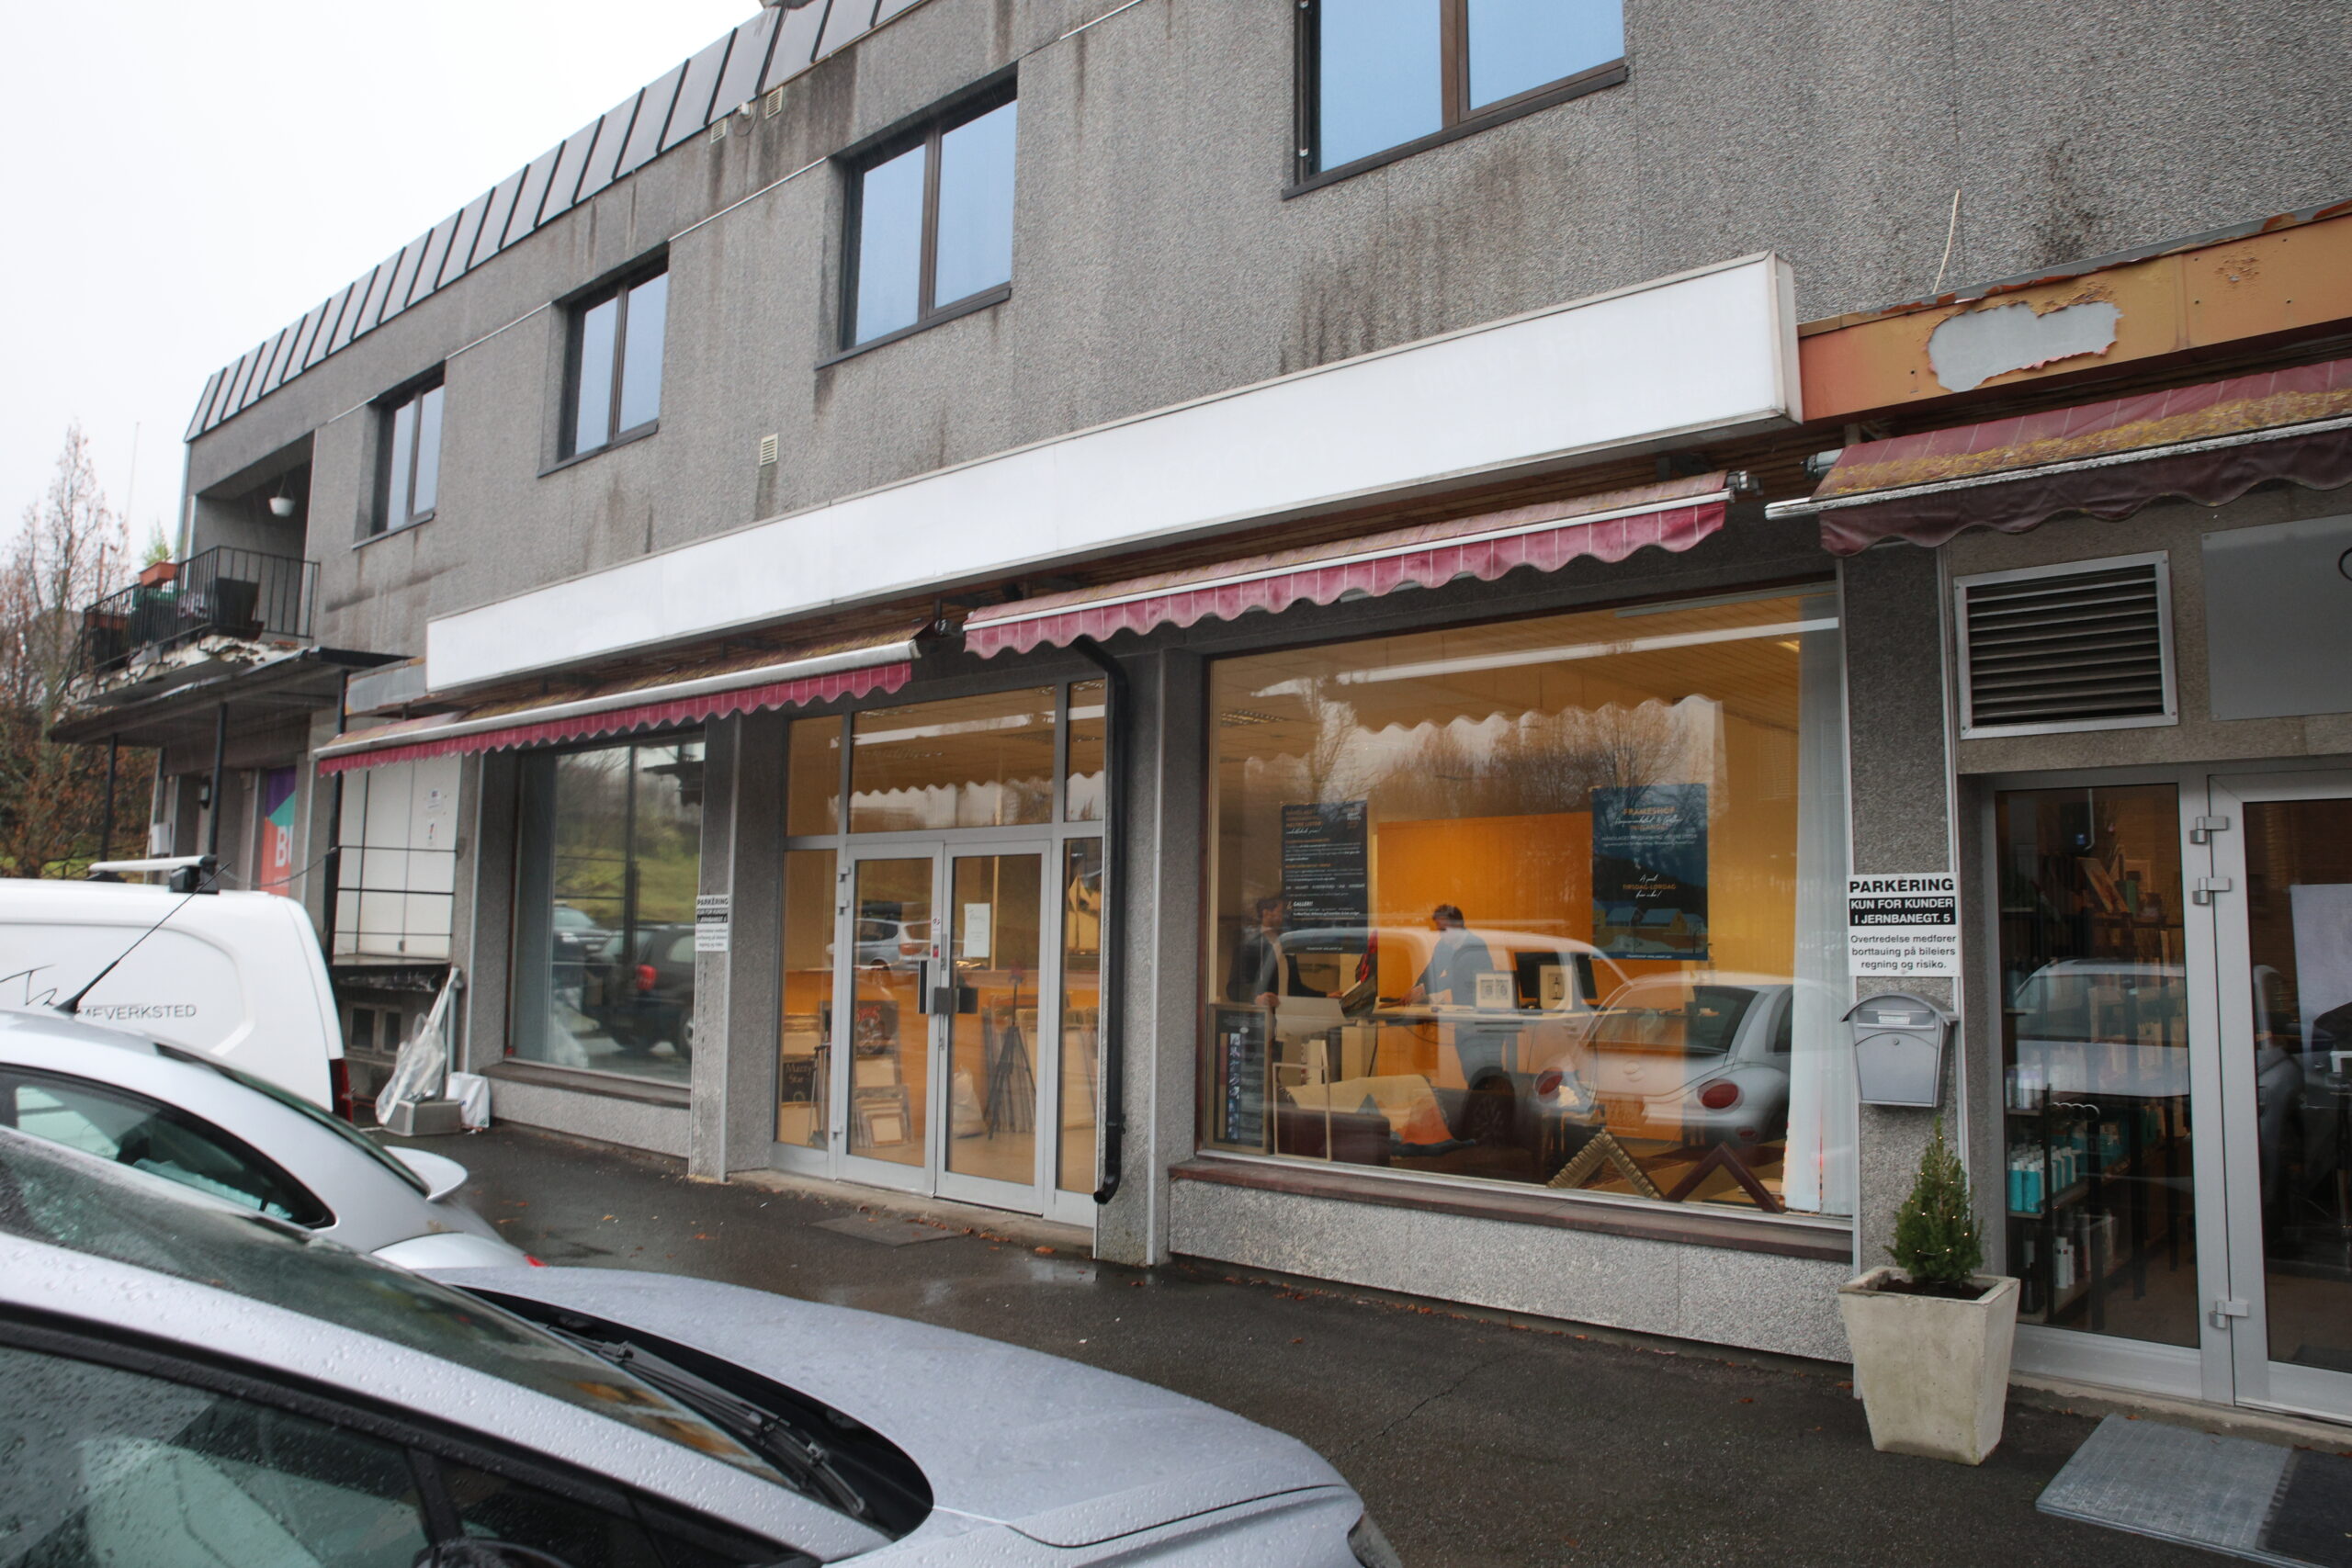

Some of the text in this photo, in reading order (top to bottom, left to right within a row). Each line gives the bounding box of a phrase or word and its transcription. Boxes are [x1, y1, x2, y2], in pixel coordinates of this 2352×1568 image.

[1849, 878, 1954, 893] PARKERING
[1850, 897, 1954, 910] KUN FOR KUNDER
[1854, 913, 1951, 924] I JERNBANEGT. 5
[1850, 935, 1910, 943] Overtredelse
[1851, 946, 1956, 956] borttauing på bileiers
[1860, 960, 1947, 970] regning og risiko.
